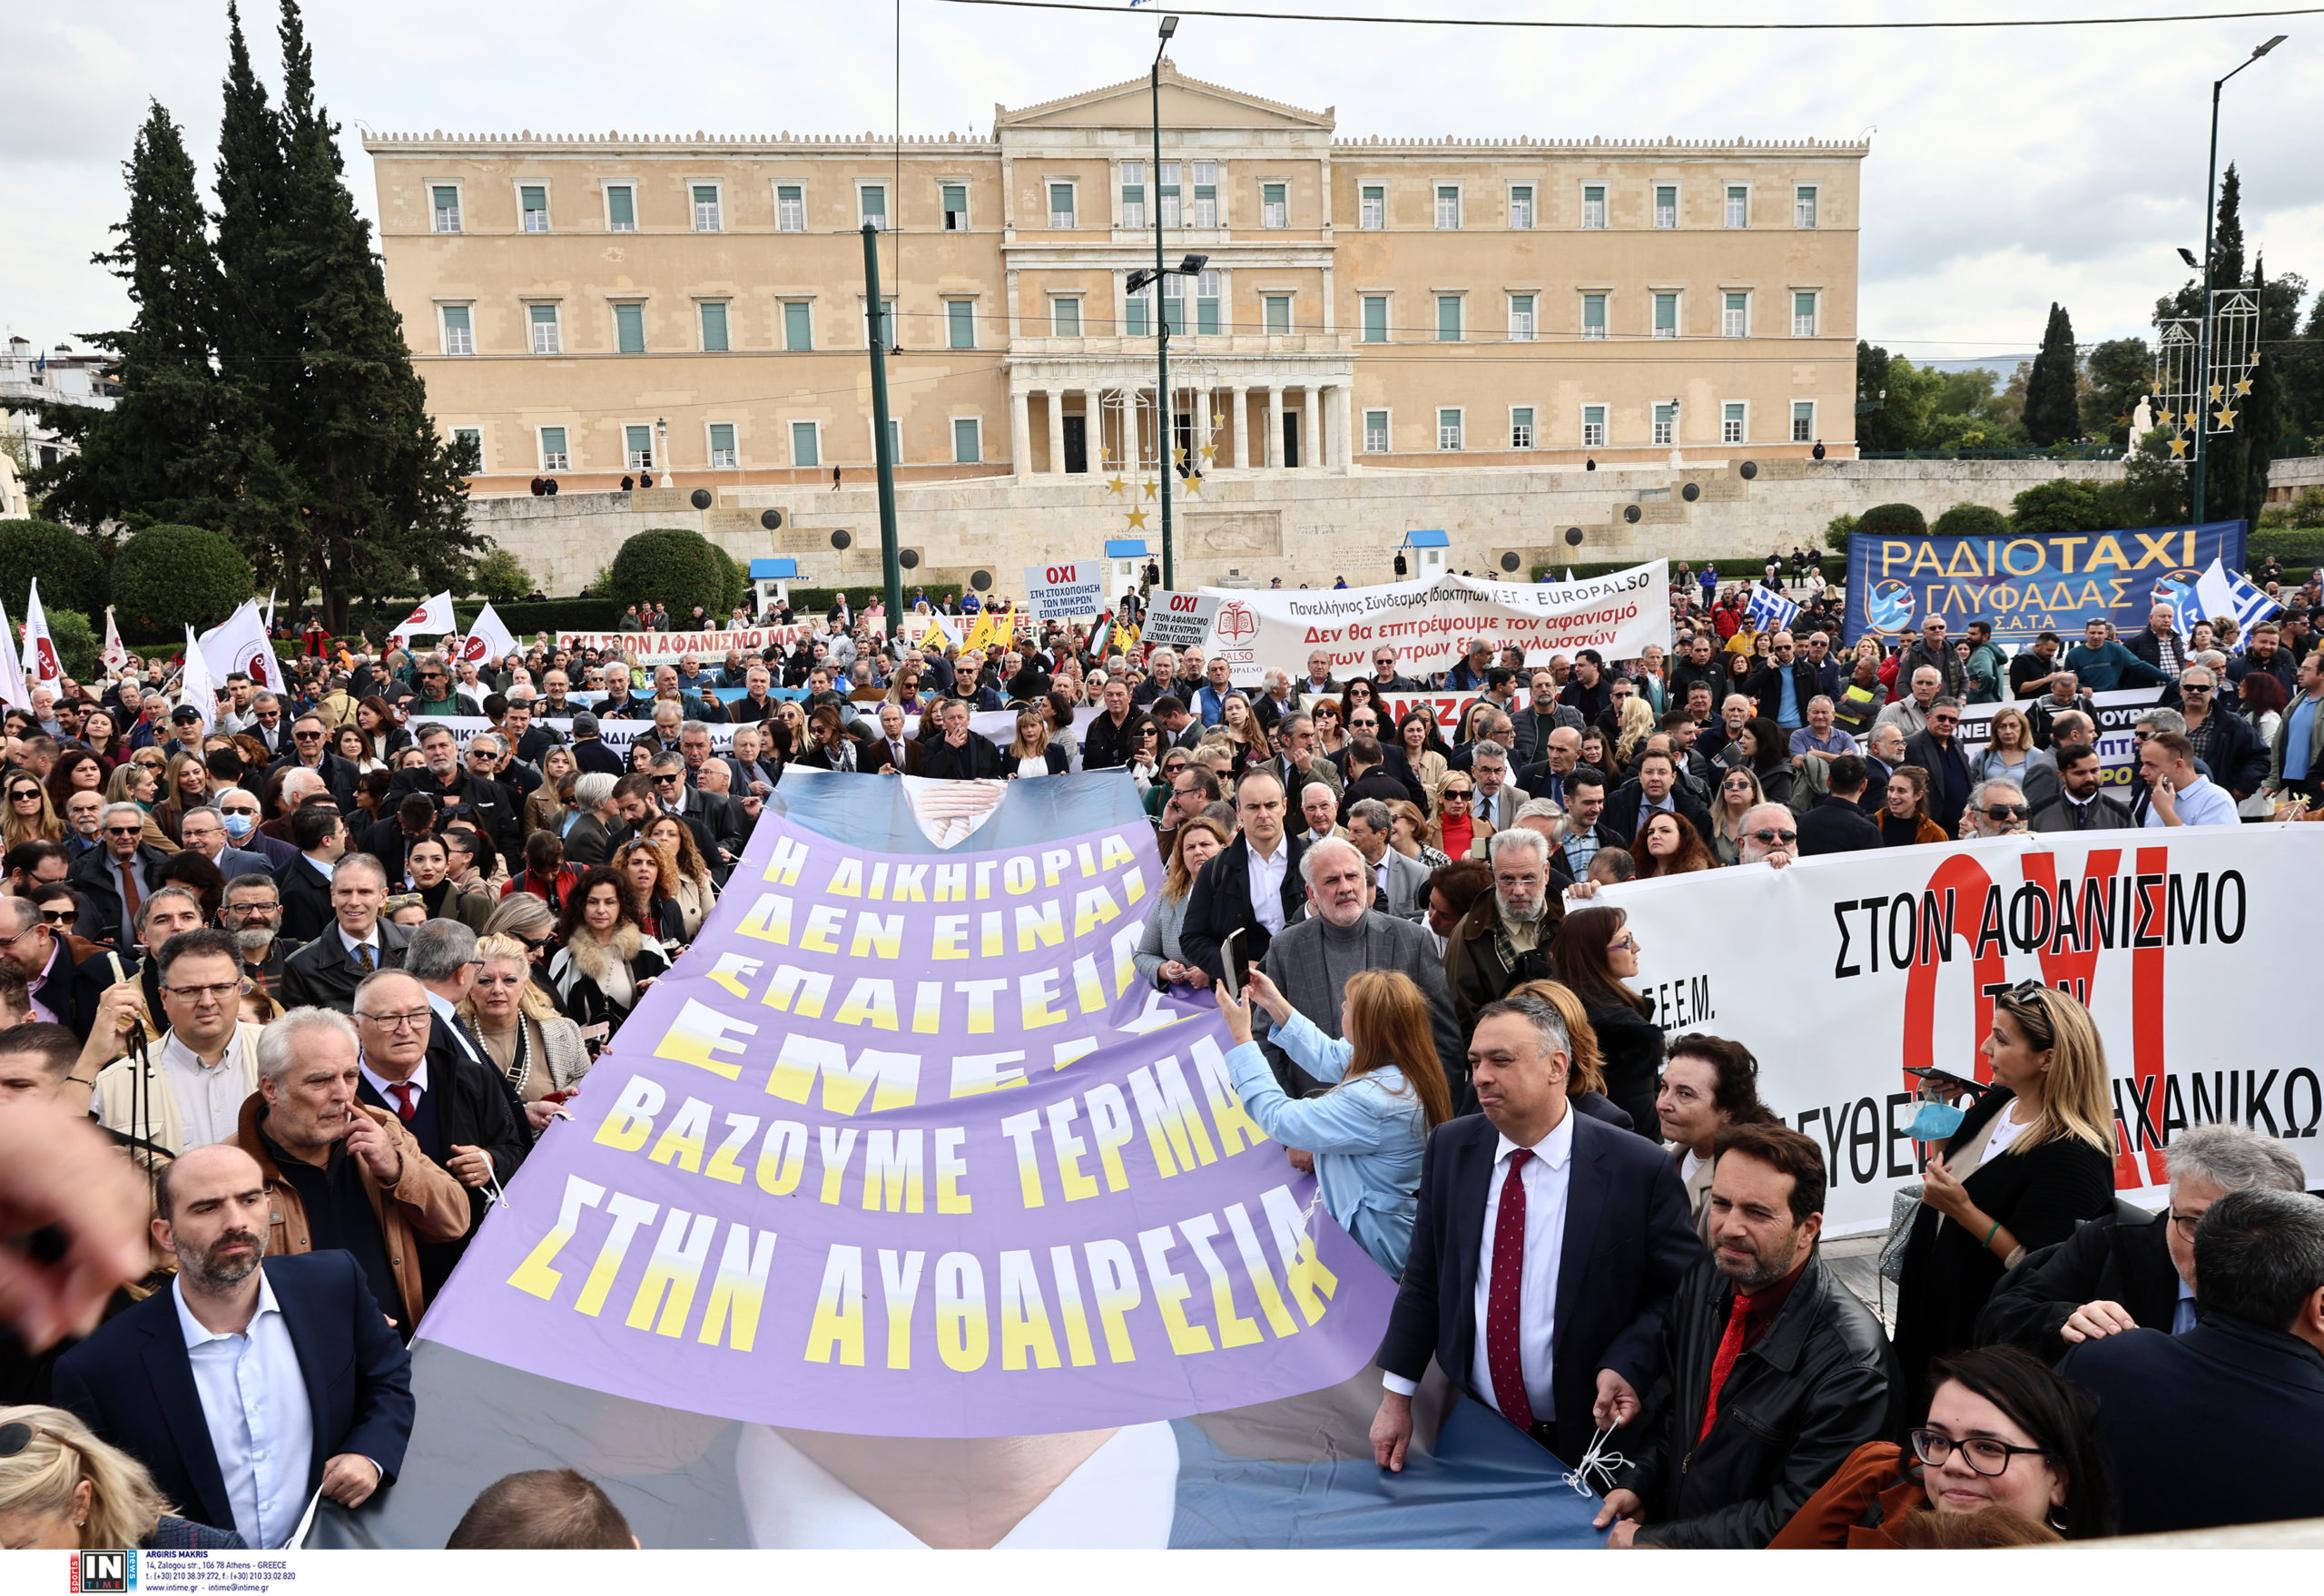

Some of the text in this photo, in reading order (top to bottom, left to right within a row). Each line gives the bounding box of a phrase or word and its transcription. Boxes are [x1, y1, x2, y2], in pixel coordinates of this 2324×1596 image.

[1046, 565, 1077, 585] ΟΧΙ
[1029, 584, 1100, 599] ΣΤΗ ΣΤΟΧΟΠΟΙΗΣΗ
[1042, 596, 1092, 608] ΤΩΝ ΜΙΚΡΩΝ
[1169, 596, 1198, 612] ΟΧΙ
[1289, 597, 1363, 617] Πανελλήνιος
[1365, 591, 1427, 610] Σύνδεσμος
[1430, 586, 1489, 605] Ιδιοκτητών
[1537, 572, 1649, 605] EUROPALSO
[1926, 577, 2133, 614] ΓΛΥΦΑΔΑΣ
[1039, 605, 1097, 619] ΕΠΙΧΕΙΡΗΣΕΩΝ
[1151, 613, 1208, 626] ΣΤΟΝ ΑΦΑΝΙΣΜΟ
[1304, 601, 1638, 643] Δεν θα επιτρέψουμε τον αφανισμό
[1994, 614, 2056, 630] Σ.Α.Τ.Α
[601, 635, 652, 654] ΣΟΝ
[657, 631, 763, 654] ΑΦΑΝΙΣΜΟ
[1146, 632, 1204, 645] ΞΕΝΩΝ ΓΛΩΣΣΩΝ
[1154, 623, 1202, 635] ΤΩΝ ΚΕΝΤΡΩΝ
[1329, 650, 1365, 666] των
[1373, 642, 1451, 663] ντρων
[1520, 629, 1617, 655] γλωσσών
[761, 833, 1136, 902] Η ΔΙΚΗΓΟΡΙΑ
[734, 865, 1147, 961] ΔΕΝ ΕΙΝΑΙ
[1834, 869, 2247, 979] ΣΤΟΝ ΑΦΑΝΙΣΜΟ
[592, 1033, 1269, 1215] ΒΑΖΟΥΜΕ ΤΕΡΜΑ
[2112, 1066, 2323, 1155] ΗΧΑΝΙΚΩ
[505, 1173, 1338, 1373] ΣΤΗΝ ΑΥΘΑΙΡΕΣΙΑ
